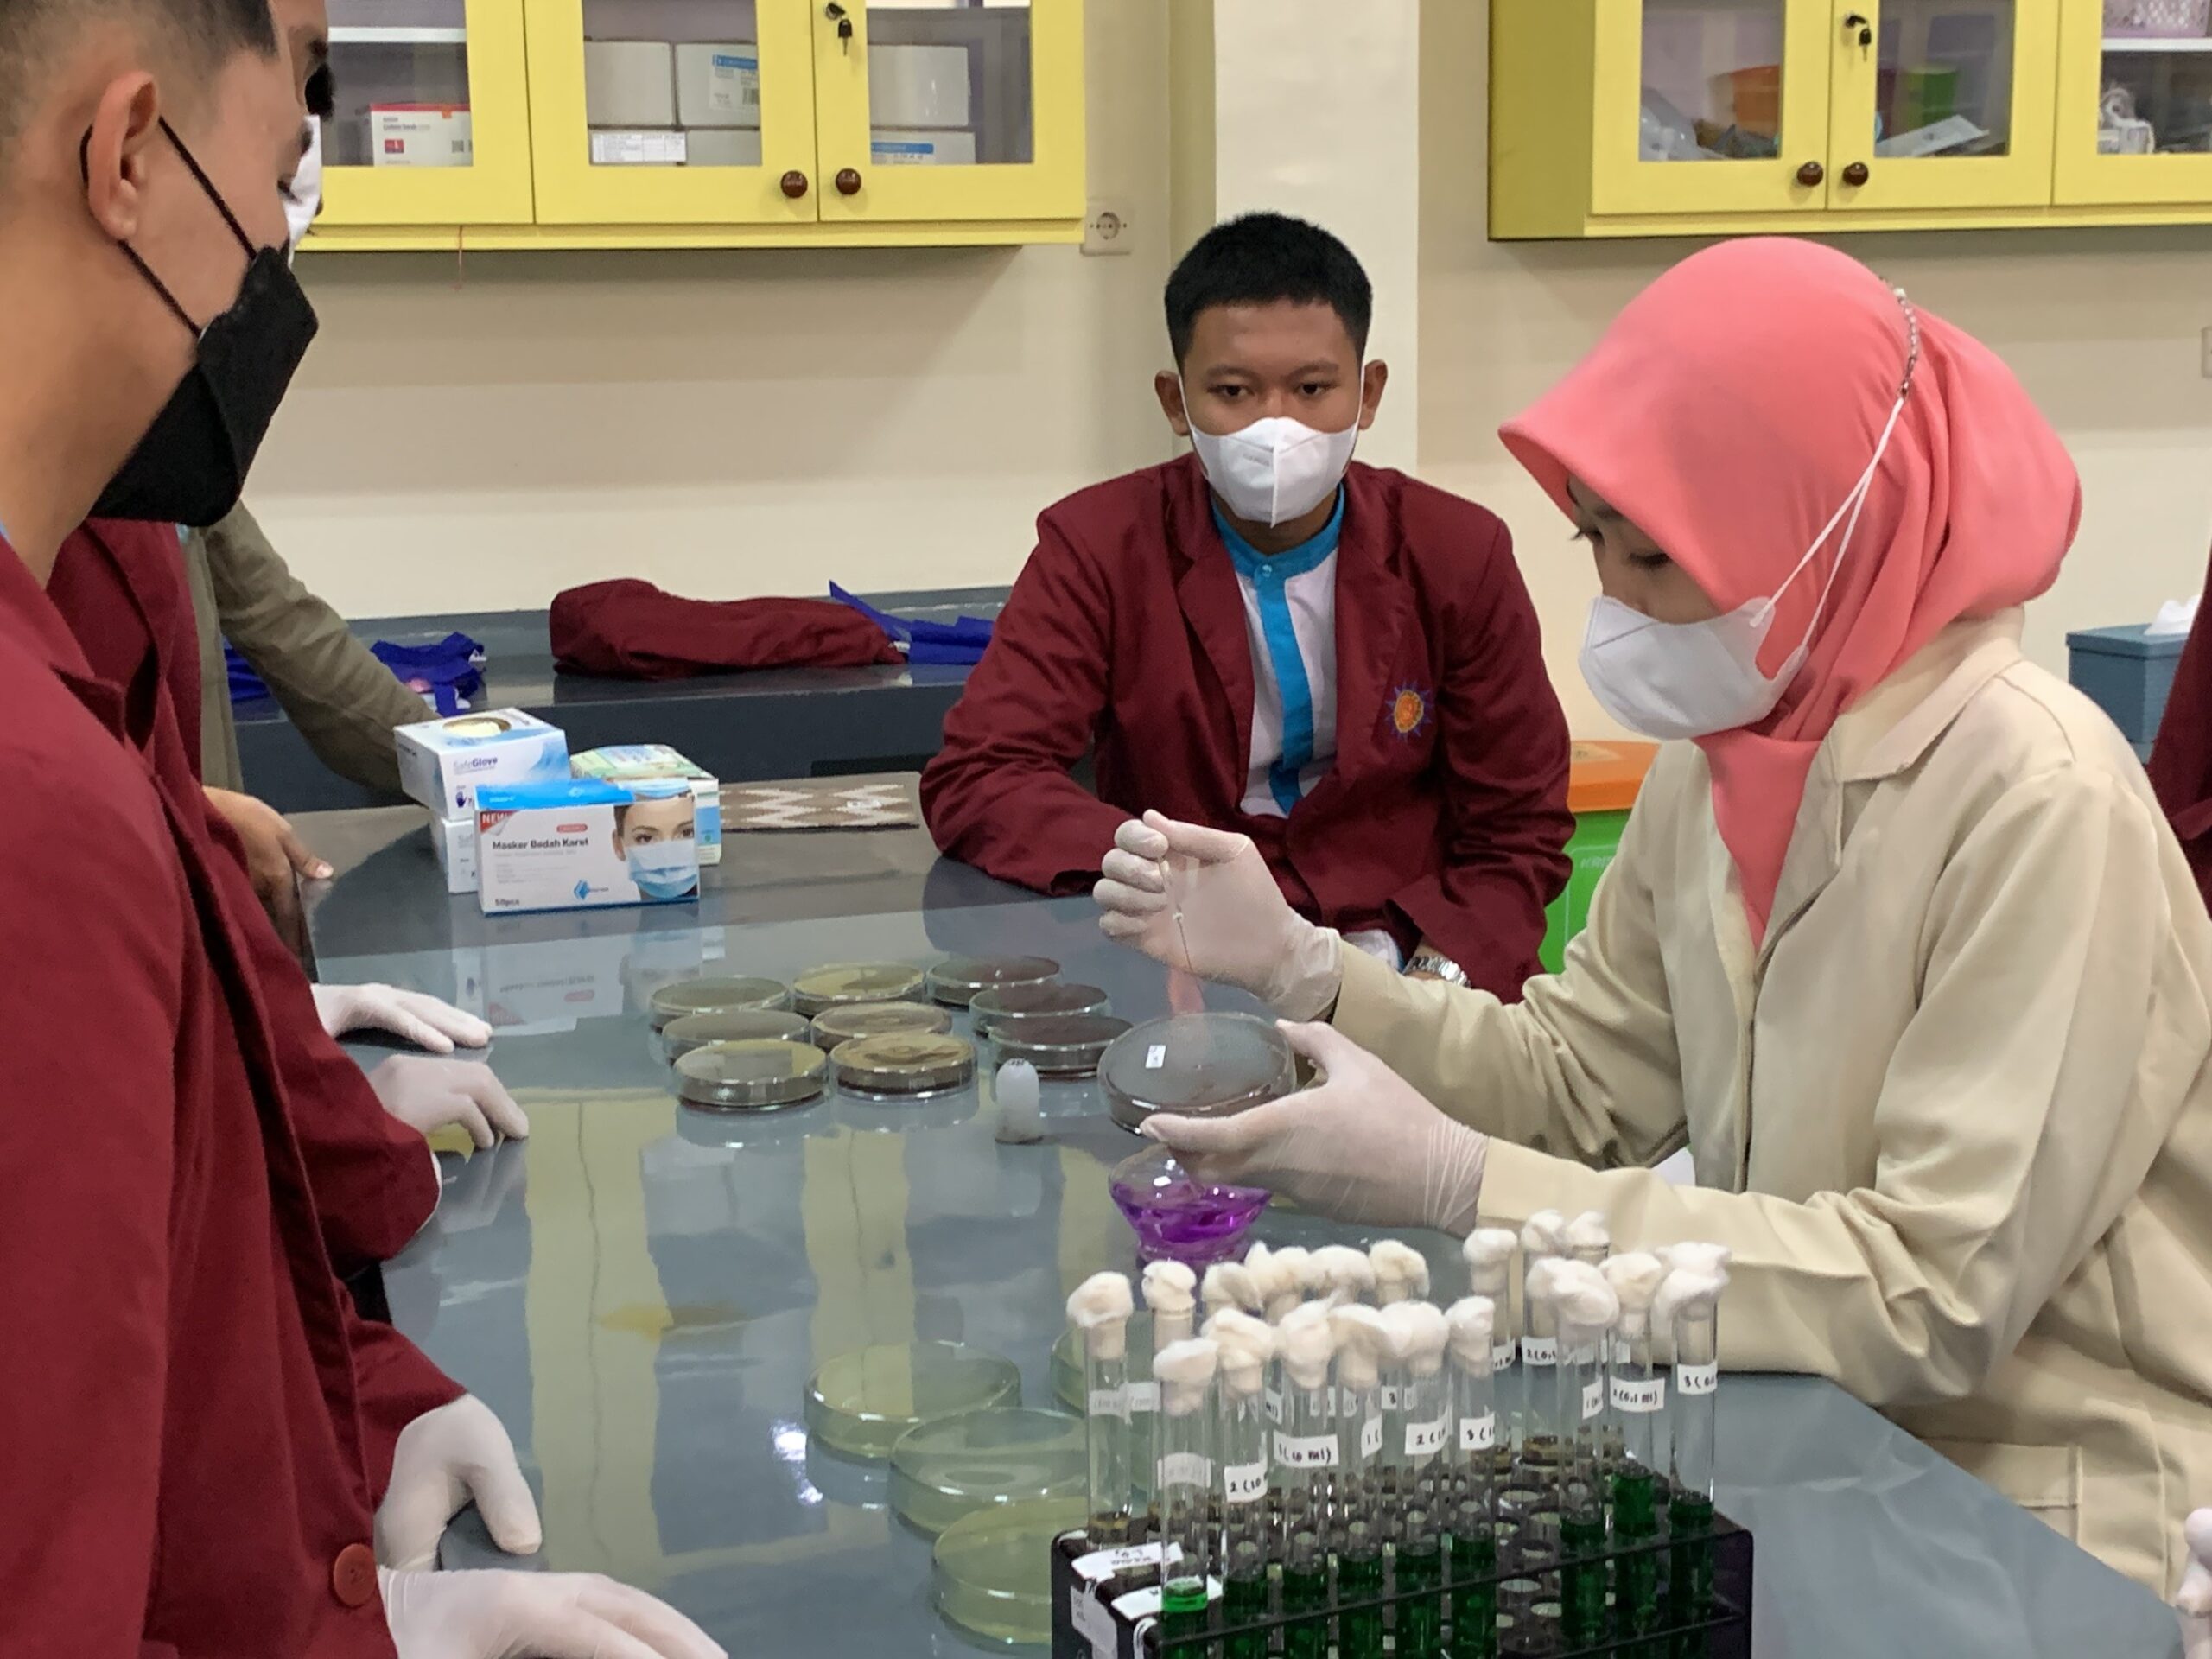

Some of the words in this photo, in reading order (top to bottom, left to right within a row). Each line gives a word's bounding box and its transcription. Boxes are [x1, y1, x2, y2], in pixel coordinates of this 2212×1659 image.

[493, 840, 528, 850] Masker
[530, 838, 561, 849] Bedah
[562, 837, 589, 847] Karet
